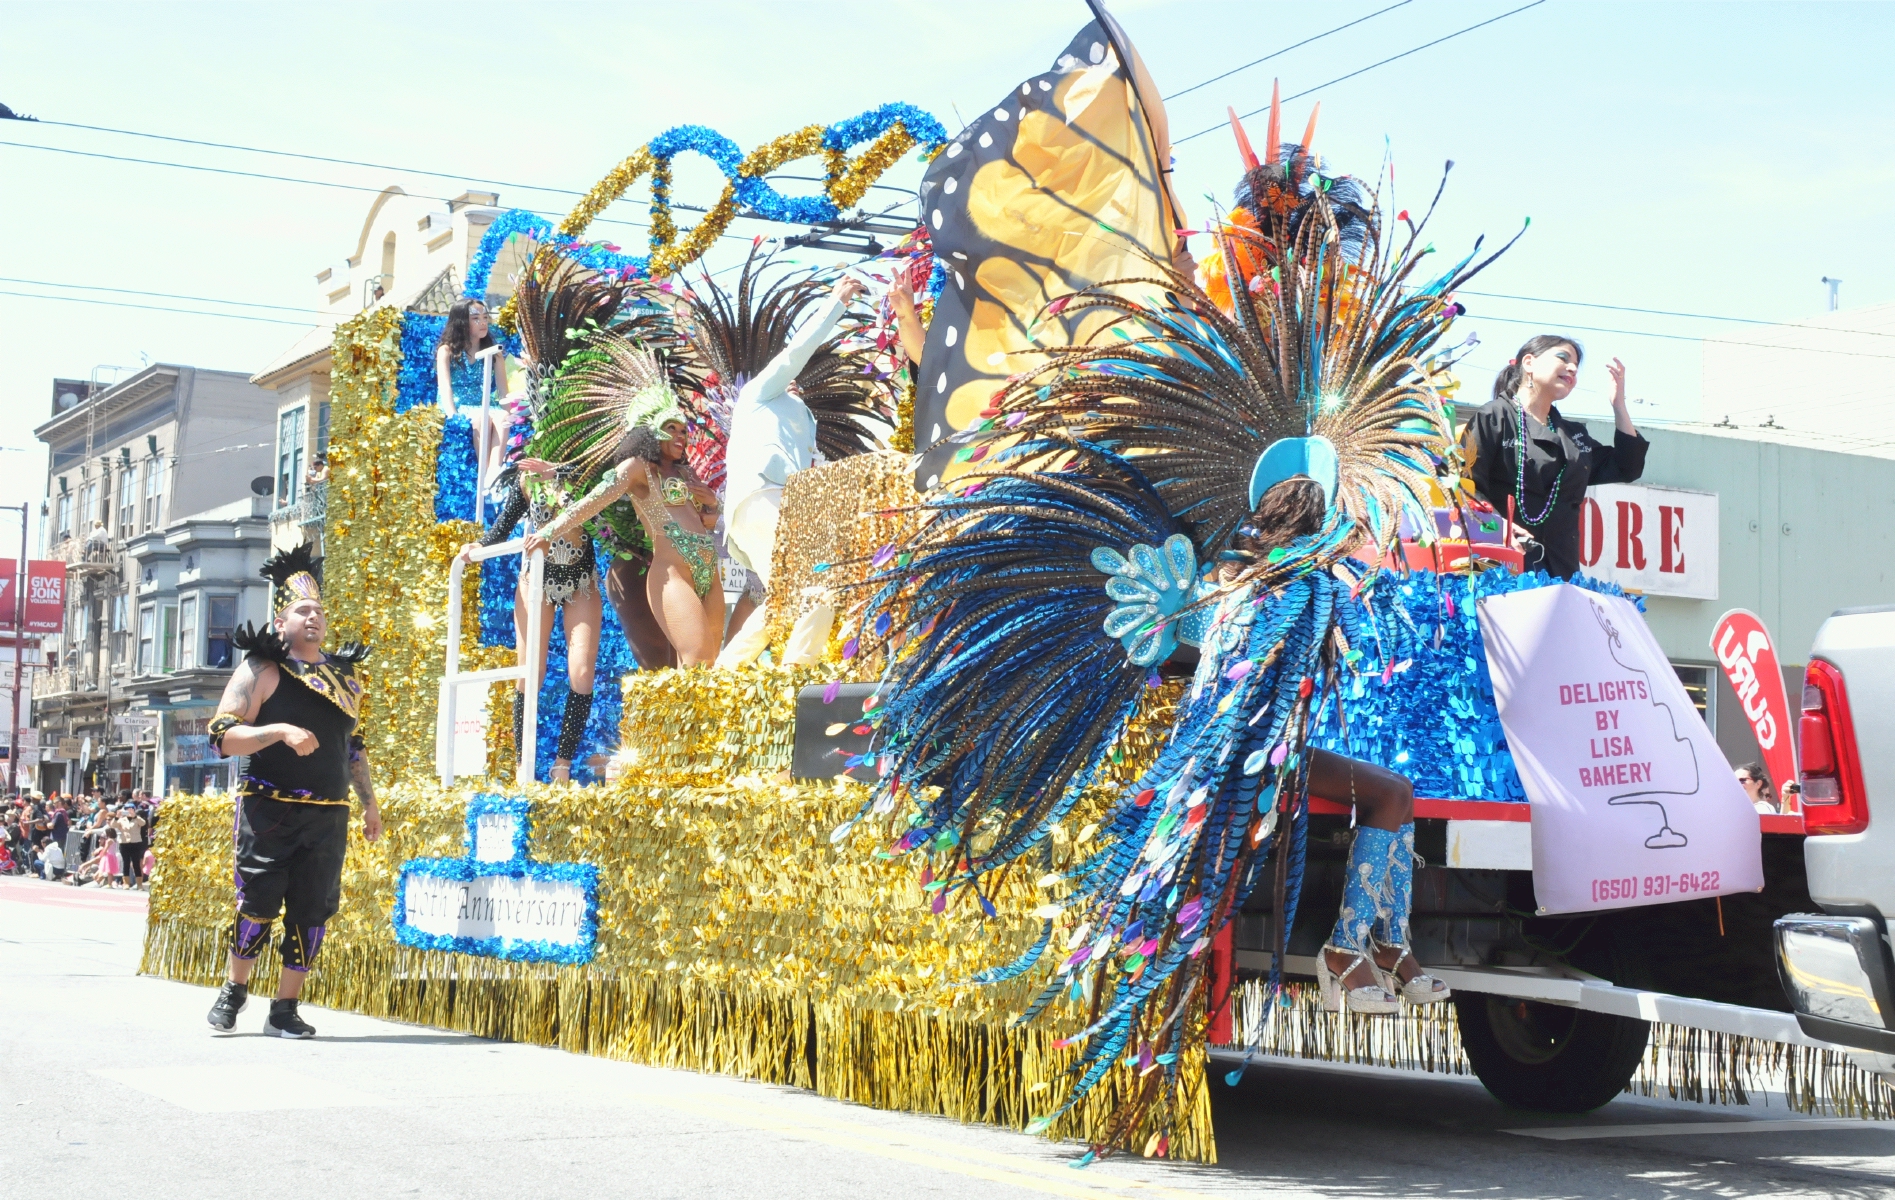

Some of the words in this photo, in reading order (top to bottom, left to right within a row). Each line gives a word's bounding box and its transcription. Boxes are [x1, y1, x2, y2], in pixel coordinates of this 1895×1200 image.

[30, 587, 61, 599] JOIN
[31, 576, 61, 589] GIVE
[1559, 680, 1648, 705] DELIGHTS
[124, 717, 150, 725] Clarion
[1595, 710, 1619, 731] BY
[1590, 736, 1634, 759] LISA
[1578, 762, 1652, 788] BAKERY
[1591, 876, 1638, 903] (650)
[1643, 871, 1720, 896] 931-6422
[457, 885, 584, 928] Anniversary
